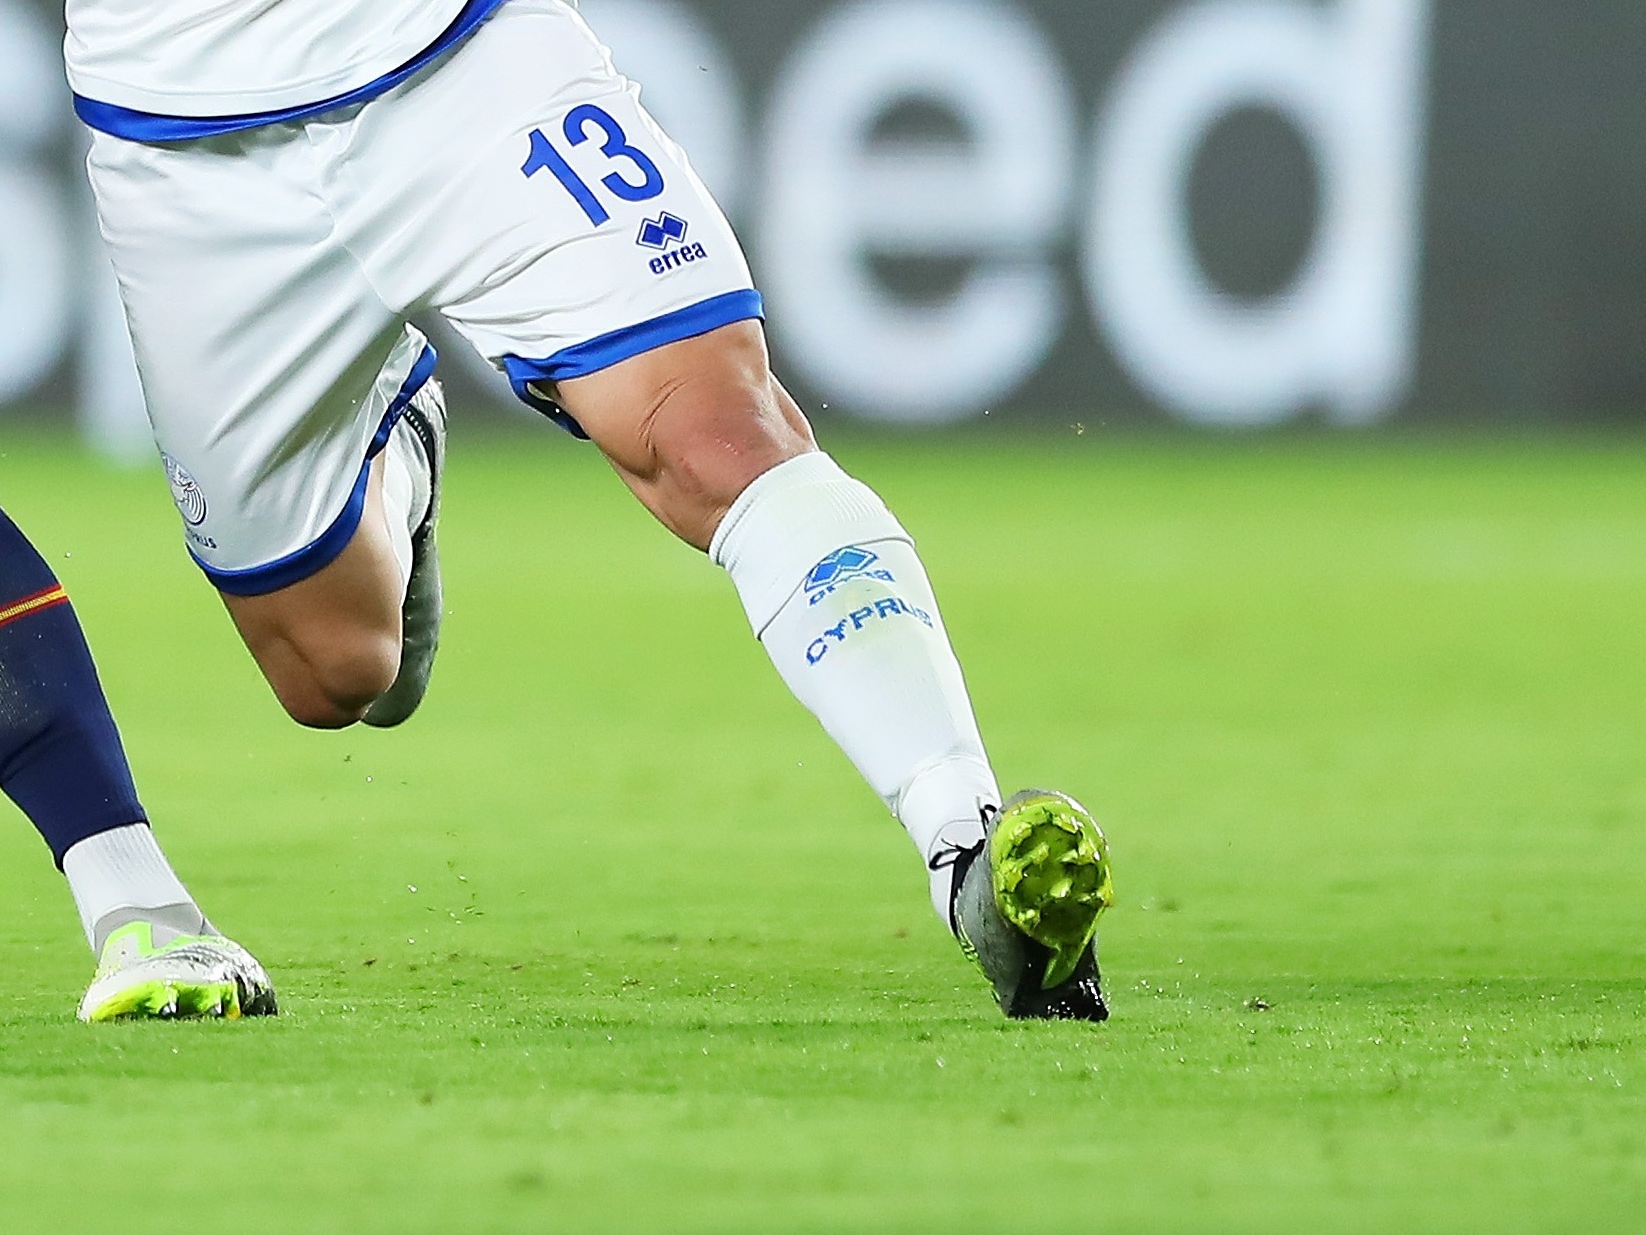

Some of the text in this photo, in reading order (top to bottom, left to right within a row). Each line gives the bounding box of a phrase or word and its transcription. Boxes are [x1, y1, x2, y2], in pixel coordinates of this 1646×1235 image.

[520, 103, 665, 228] 13
[648, 241, 708, 275] errea
[806, 597, 934, 665] CYPRUS
